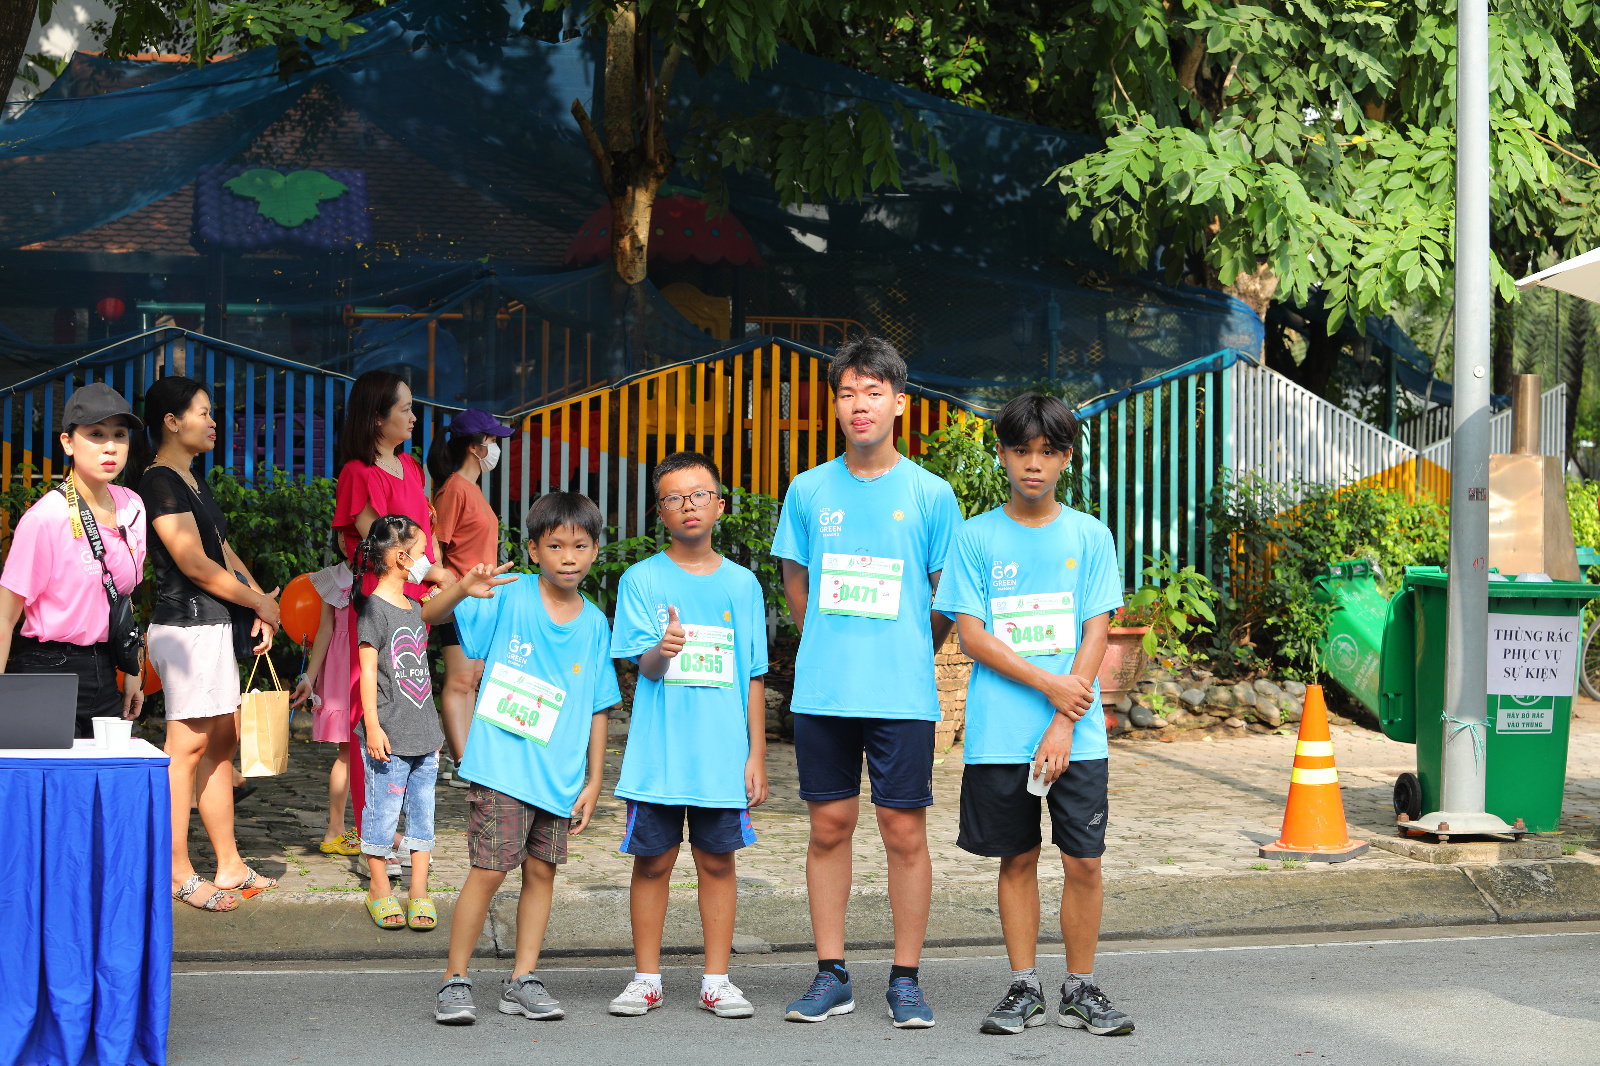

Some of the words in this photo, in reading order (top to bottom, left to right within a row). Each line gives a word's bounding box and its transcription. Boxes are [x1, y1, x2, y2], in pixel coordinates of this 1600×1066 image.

[819, 510, 844, 526] GO
[819, 525, 842, 533] GREEN
[991, 564, 1018, 580] GO
[992, 578, 1017, 587] GREEN
[840, 584, 878, 604] 0471
[1011, 624, 1056, 645] 0484
[1494, 626, 1543, 642] THÙNG
[1546, 627, 1574, 643] RÁC
[508, 638, 533, 658] GO
[1502, 648, 1541, 664] PHỤC
[1544, 649, 1563, 664] VỤ
[506, 651, 528, 665] GREEN
[680, 652, 723, 674] 0355
[395, 669, 408, 678] ALL
[409, 669, 423, 677] FOR
[1503, 665, 1524, 682] SỰ
[1525, 666, 1558, 682] KIỆN
[496, 697, 540, 727] 0459
[1531, 711, 1545, 719] RÁC
